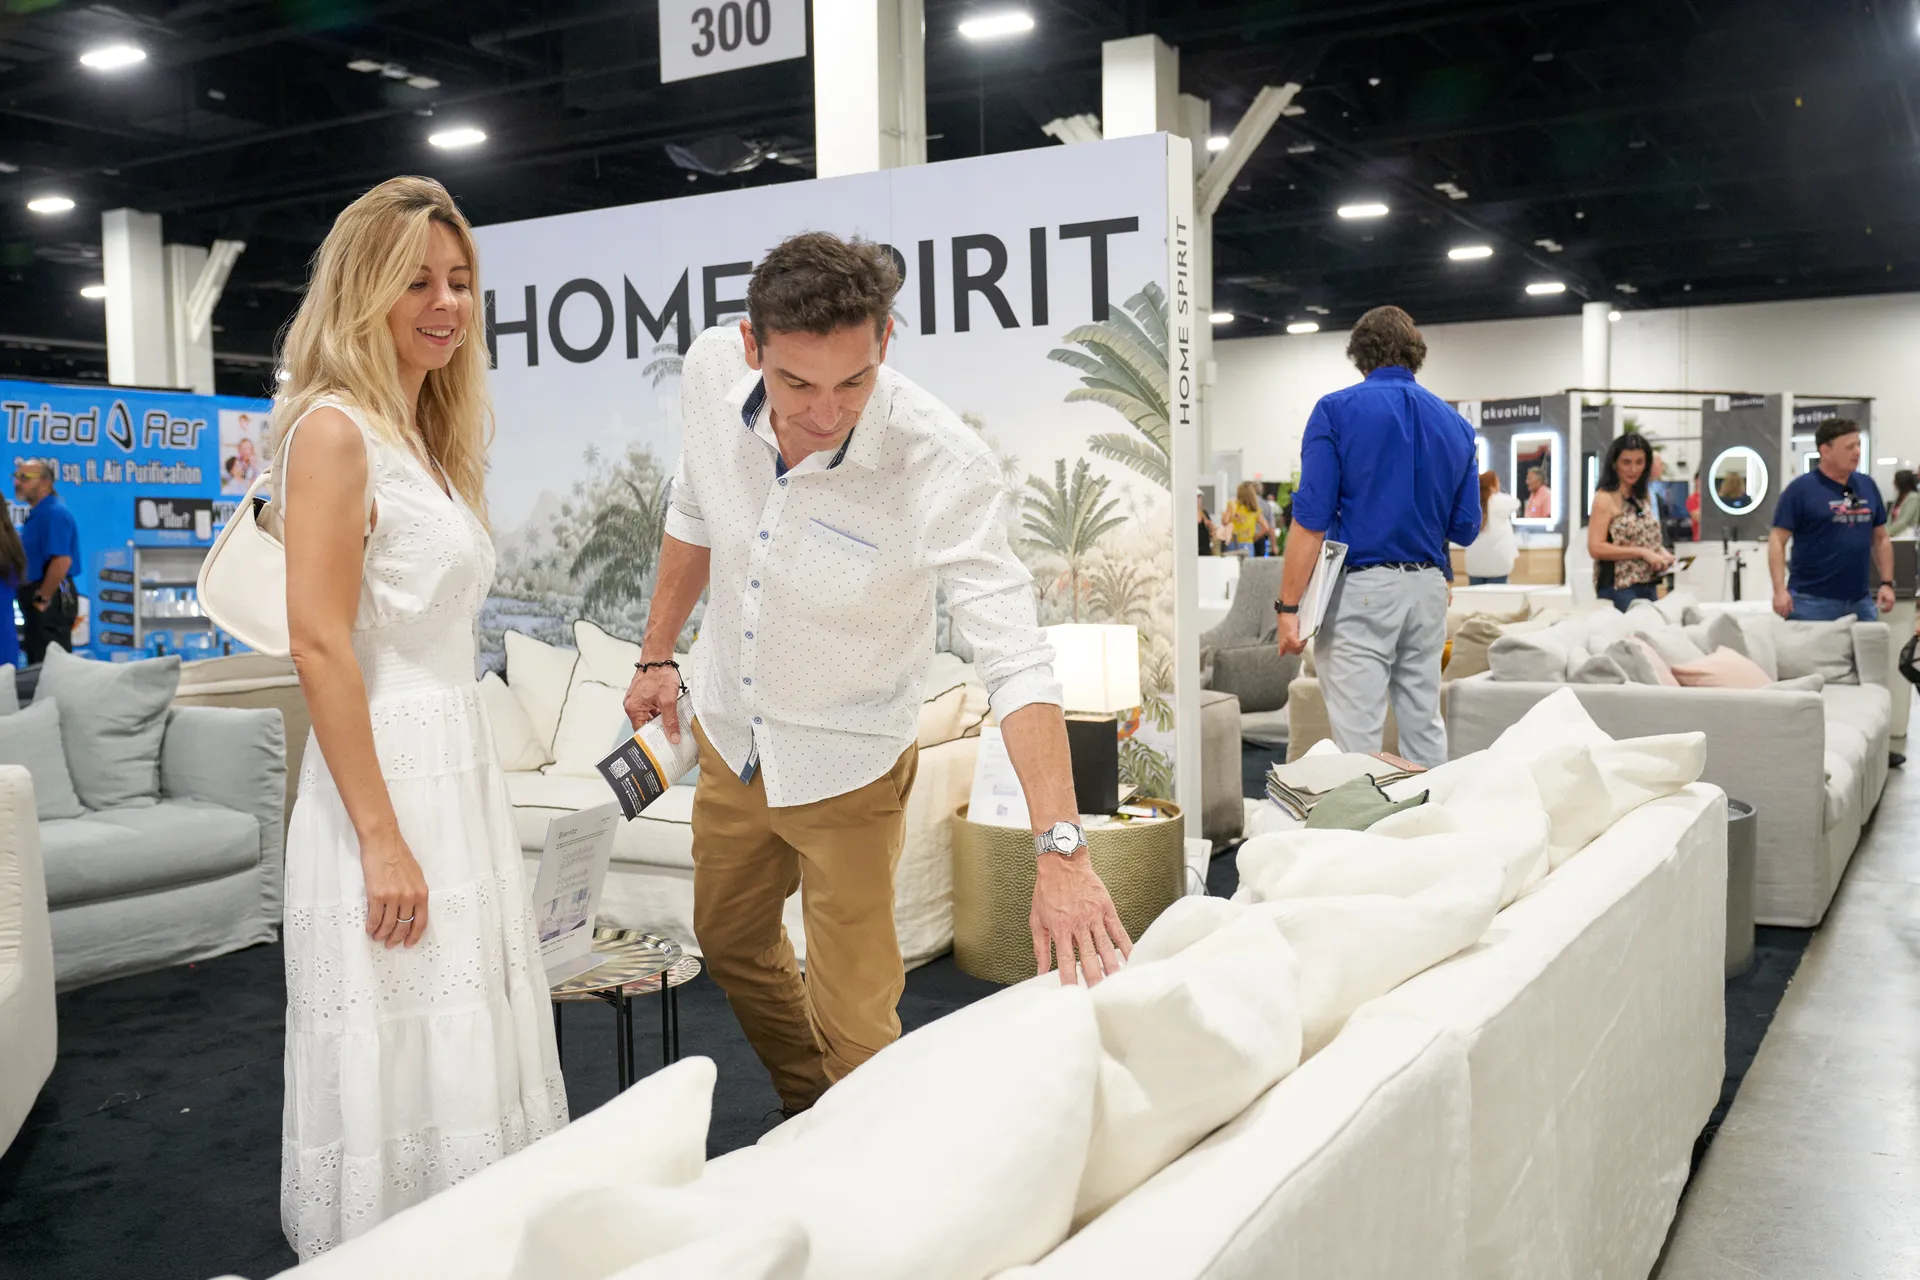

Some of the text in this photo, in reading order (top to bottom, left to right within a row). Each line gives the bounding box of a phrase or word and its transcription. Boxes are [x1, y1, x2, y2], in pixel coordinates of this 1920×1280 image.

[691, 0, 771, 57] 300
[880, 216, 1139, 336] IRIT
[1175, 216, 1190, 424] HOME SPIRIT
[3, 402, 207, 449] Triad Aer
[1482, 404, 1540, 420] akuavitus
[103, 459, 122, 483] Air
[125, 460, 202, 484] Purification
